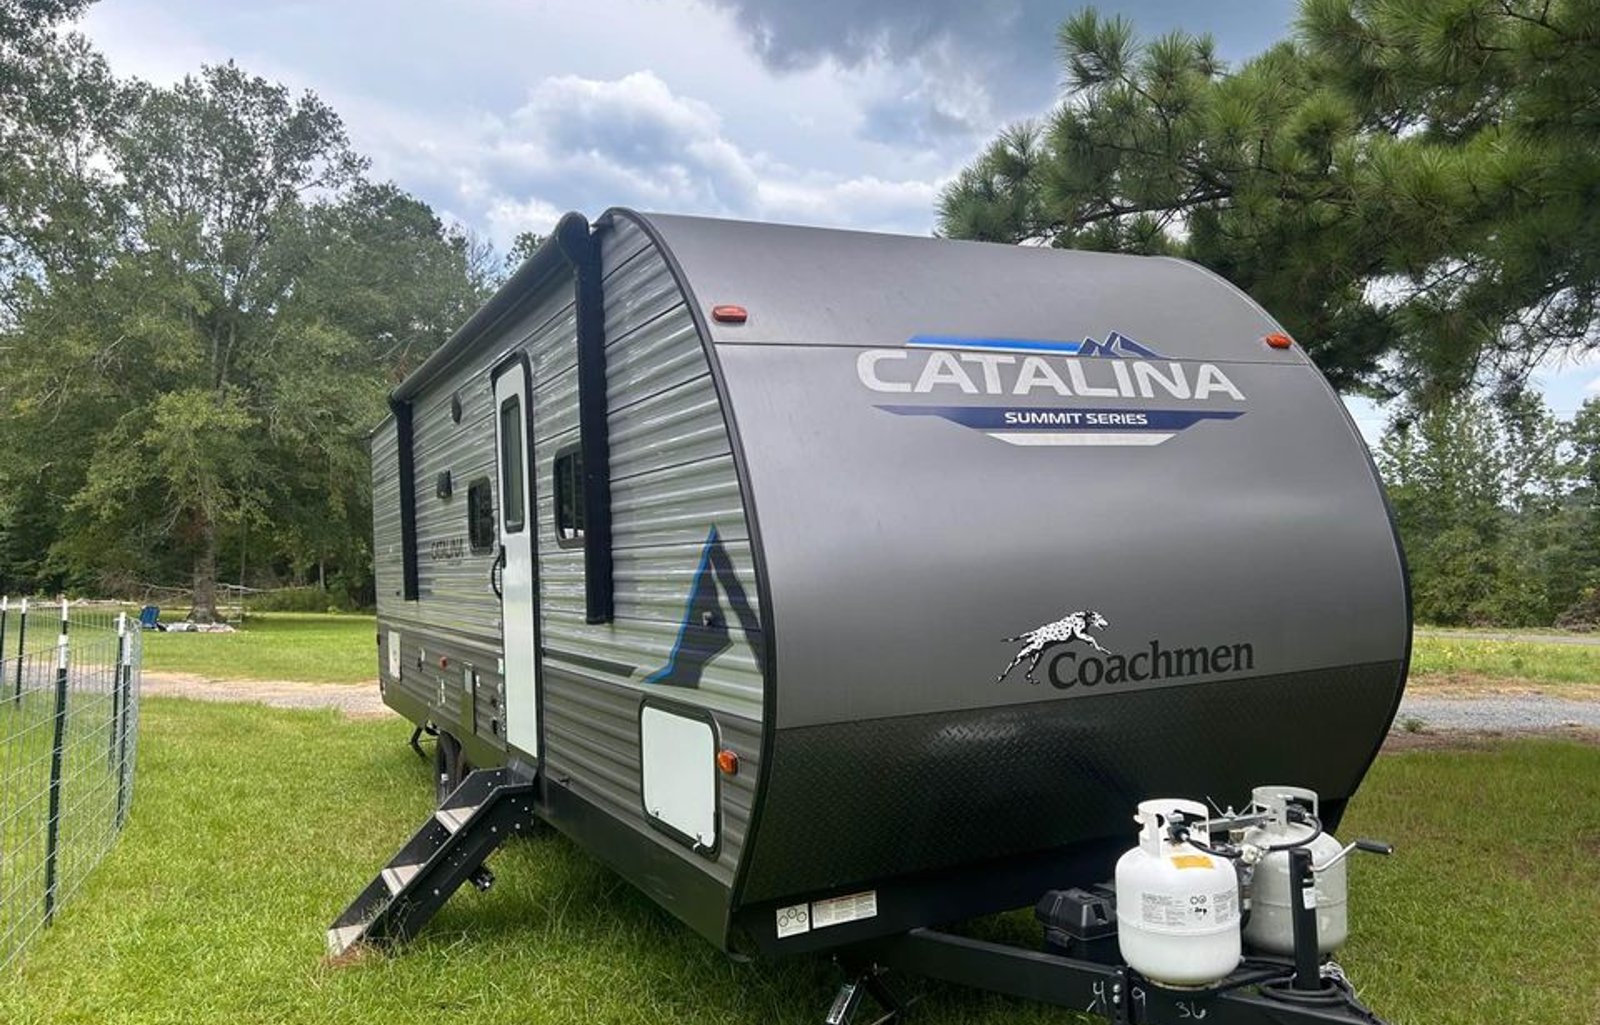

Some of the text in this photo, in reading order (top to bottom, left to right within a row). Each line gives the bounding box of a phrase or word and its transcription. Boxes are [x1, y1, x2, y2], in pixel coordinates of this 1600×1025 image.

[856, 349, 1247, 400] CATALINA
[1005, 411, 1148, 426] SUMMIT SERIES
[1048, 640, 1254, 689] Coachmen
